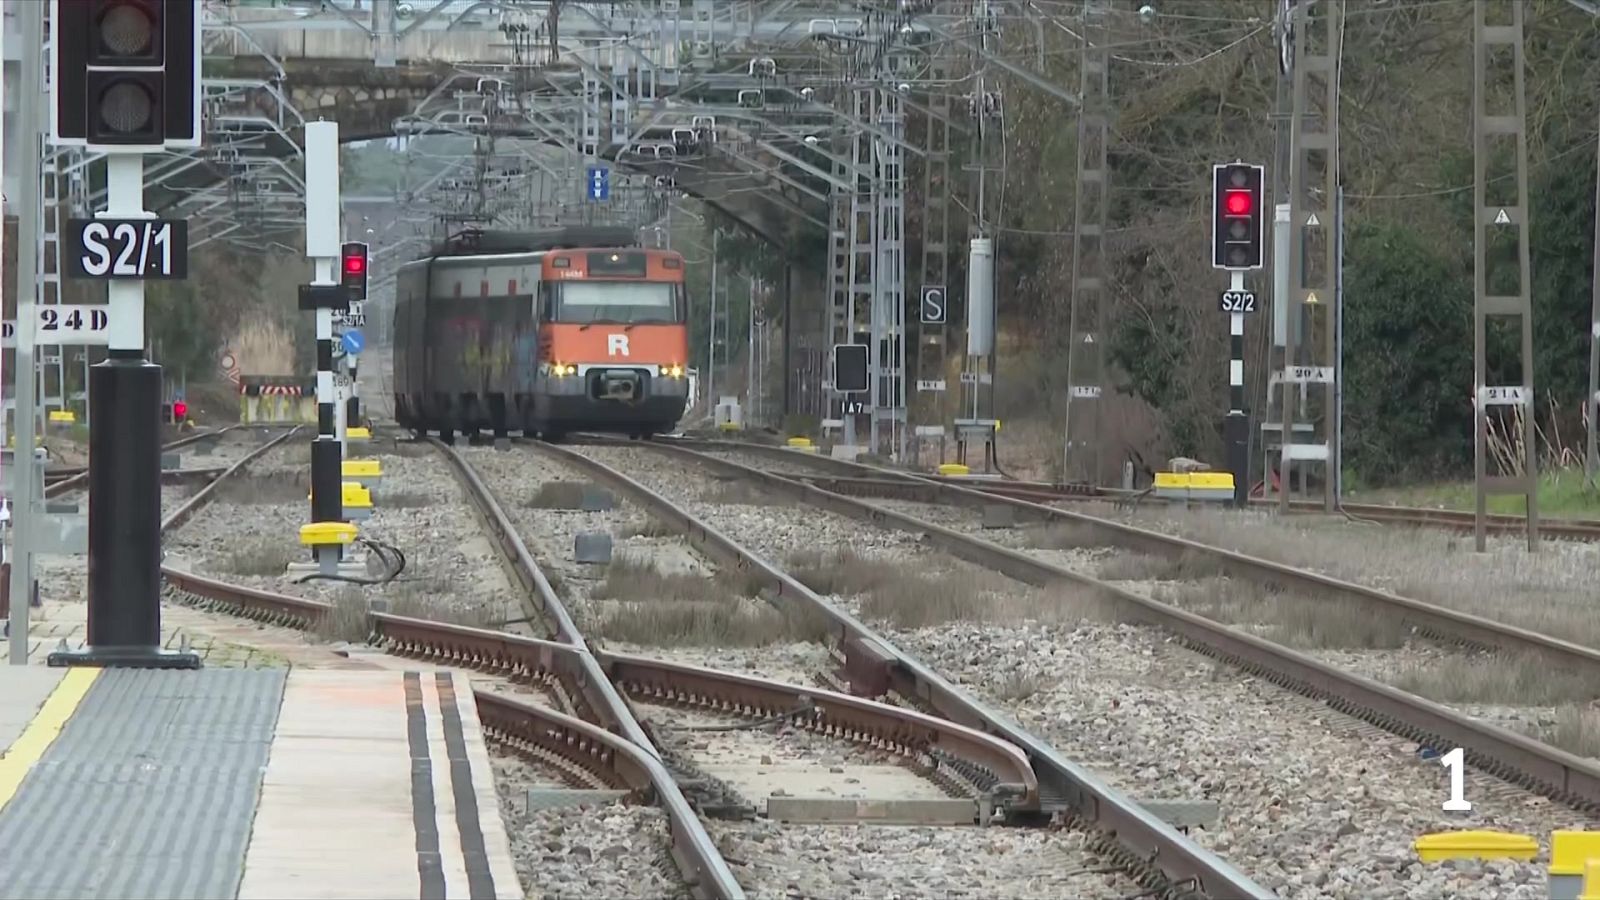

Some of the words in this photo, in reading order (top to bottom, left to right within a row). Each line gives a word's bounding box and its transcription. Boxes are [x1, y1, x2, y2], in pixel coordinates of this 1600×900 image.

[82, 222, 171, 276] S2/1
[925, 289, 942, 320] S
[1222, 293, 1254, 312] S2/2
[608, 334, 630, 356] R
